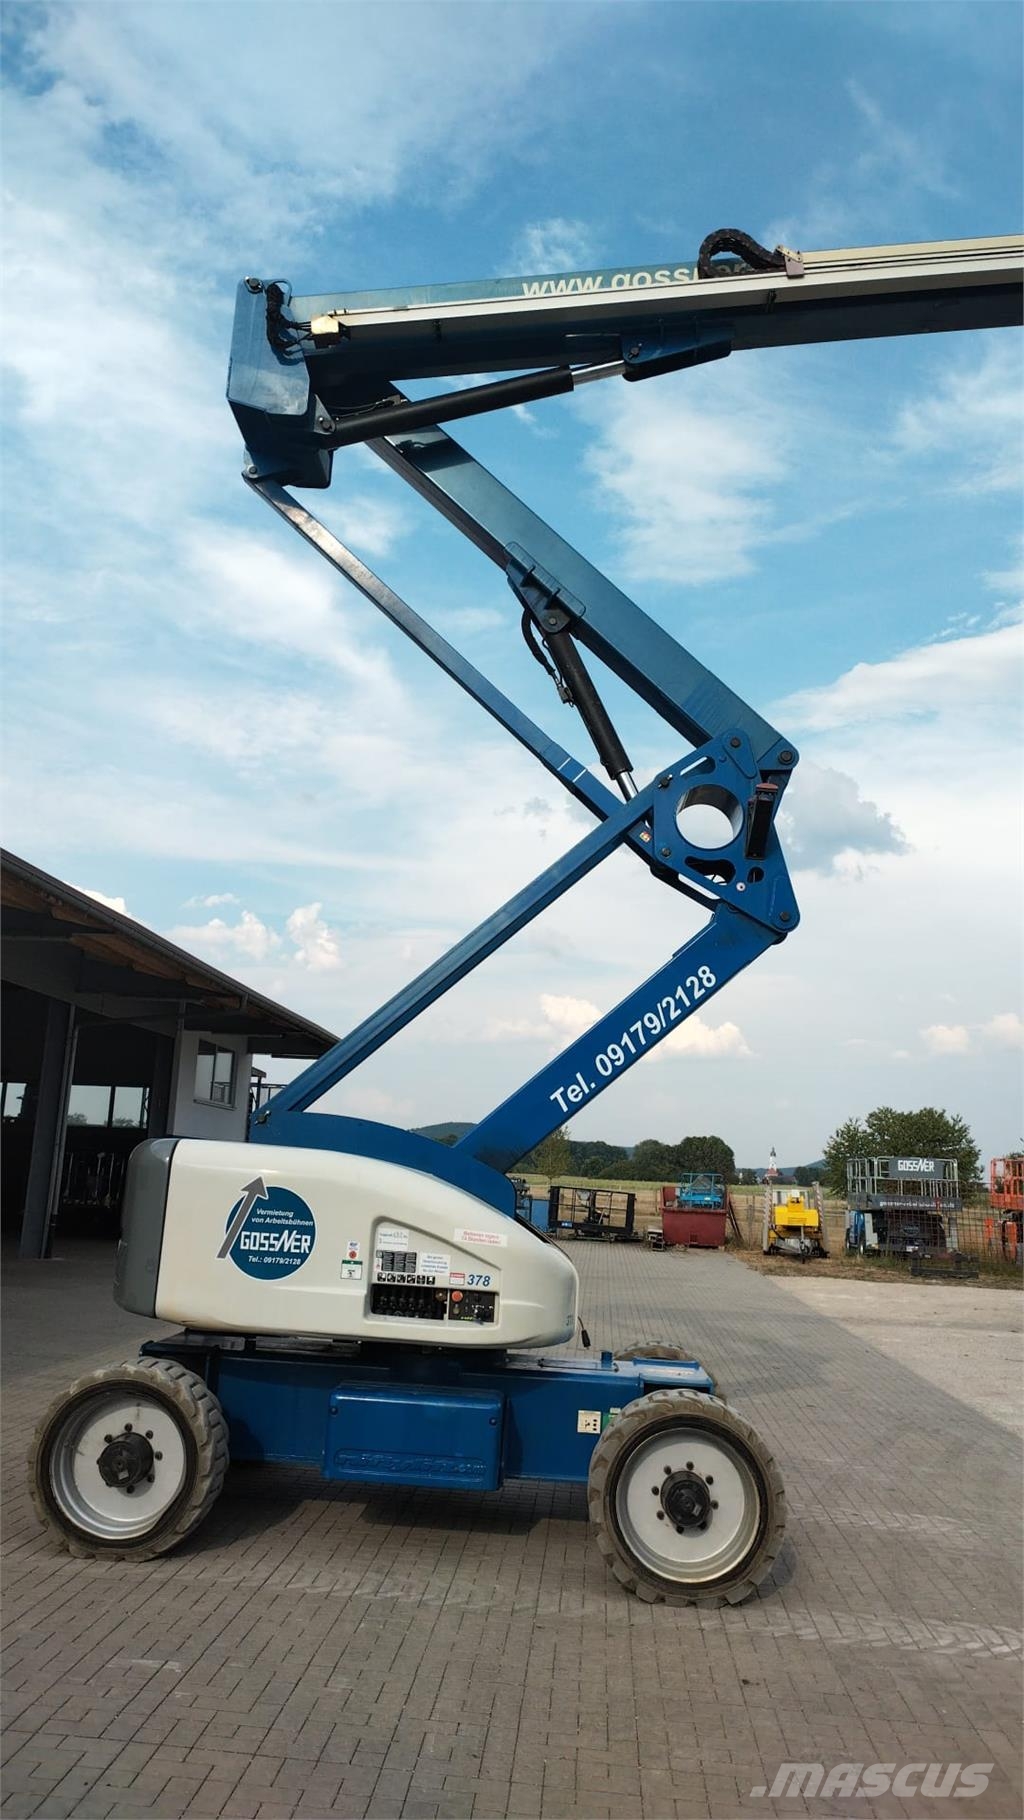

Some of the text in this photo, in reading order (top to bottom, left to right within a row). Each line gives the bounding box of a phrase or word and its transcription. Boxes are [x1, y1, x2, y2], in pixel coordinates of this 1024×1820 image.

[549, 964, 717, 1113] Tel. 09179/2128
[898, 1159, 935, 1172] GOSSNER
[257, 1208, 294, 1217] Vermietung
[264, 1217, 314, 1226] Arbeitsbühnen
[241, 1230, 311, 1253] GOSSNER
[263, 1257, 301, 1265] 09179/2128
[467, 1274, 491, 1287] 378
